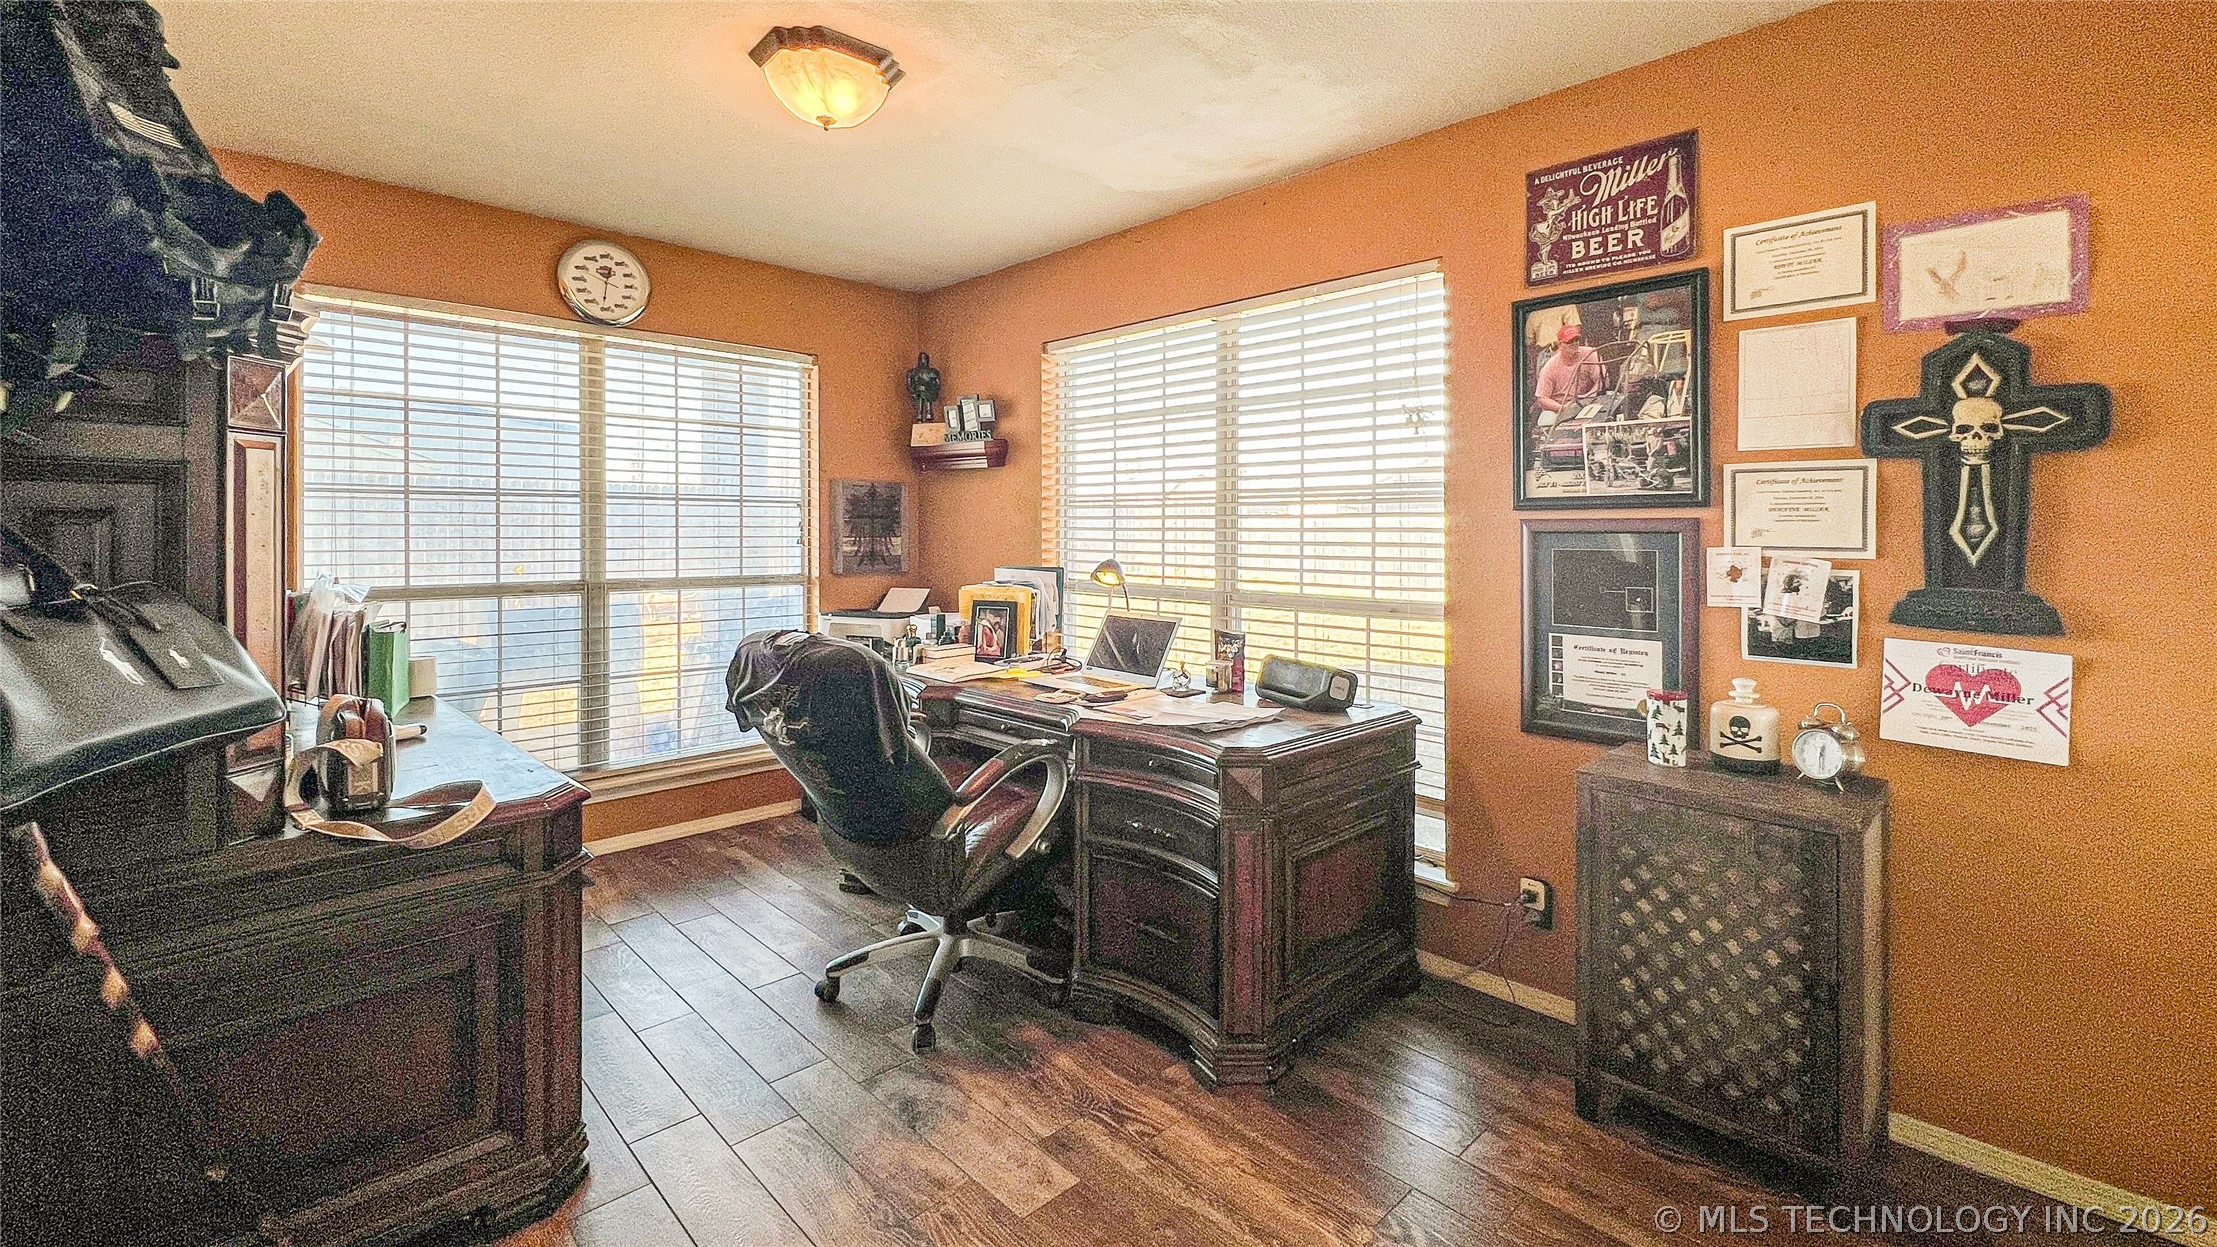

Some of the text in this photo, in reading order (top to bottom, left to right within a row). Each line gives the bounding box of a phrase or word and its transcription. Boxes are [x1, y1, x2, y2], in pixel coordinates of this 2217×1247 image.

[1534, 155, 1624, 185] A DELIGHTFUL BEVERAGE
[1579, 147, 1678, 207] Miller
[1568, 194, 1659, 232] HIGH LIFE
[1601, 223, 1629, 234] Leading
[1629, 216, 1658, 229] Bottled
[1755, 234, 1789, 246] Certificate
[1790, 231, 1799, 241] of
[1798, 225, 1843, 239] Achievement
[1571, 229, 1645, 260] BEER
[1611, 252, 1637, 261] PLEASE
[1638, 248, 1652, 256] YOU
[944, 429, 994, 443] MEMORIES
[1755, 477, 1843, 487] Certificate of Achievement
[1573, 644, 1607, 653] Certificate
[1911, 682, 2035, 705] Dewayne Miller
